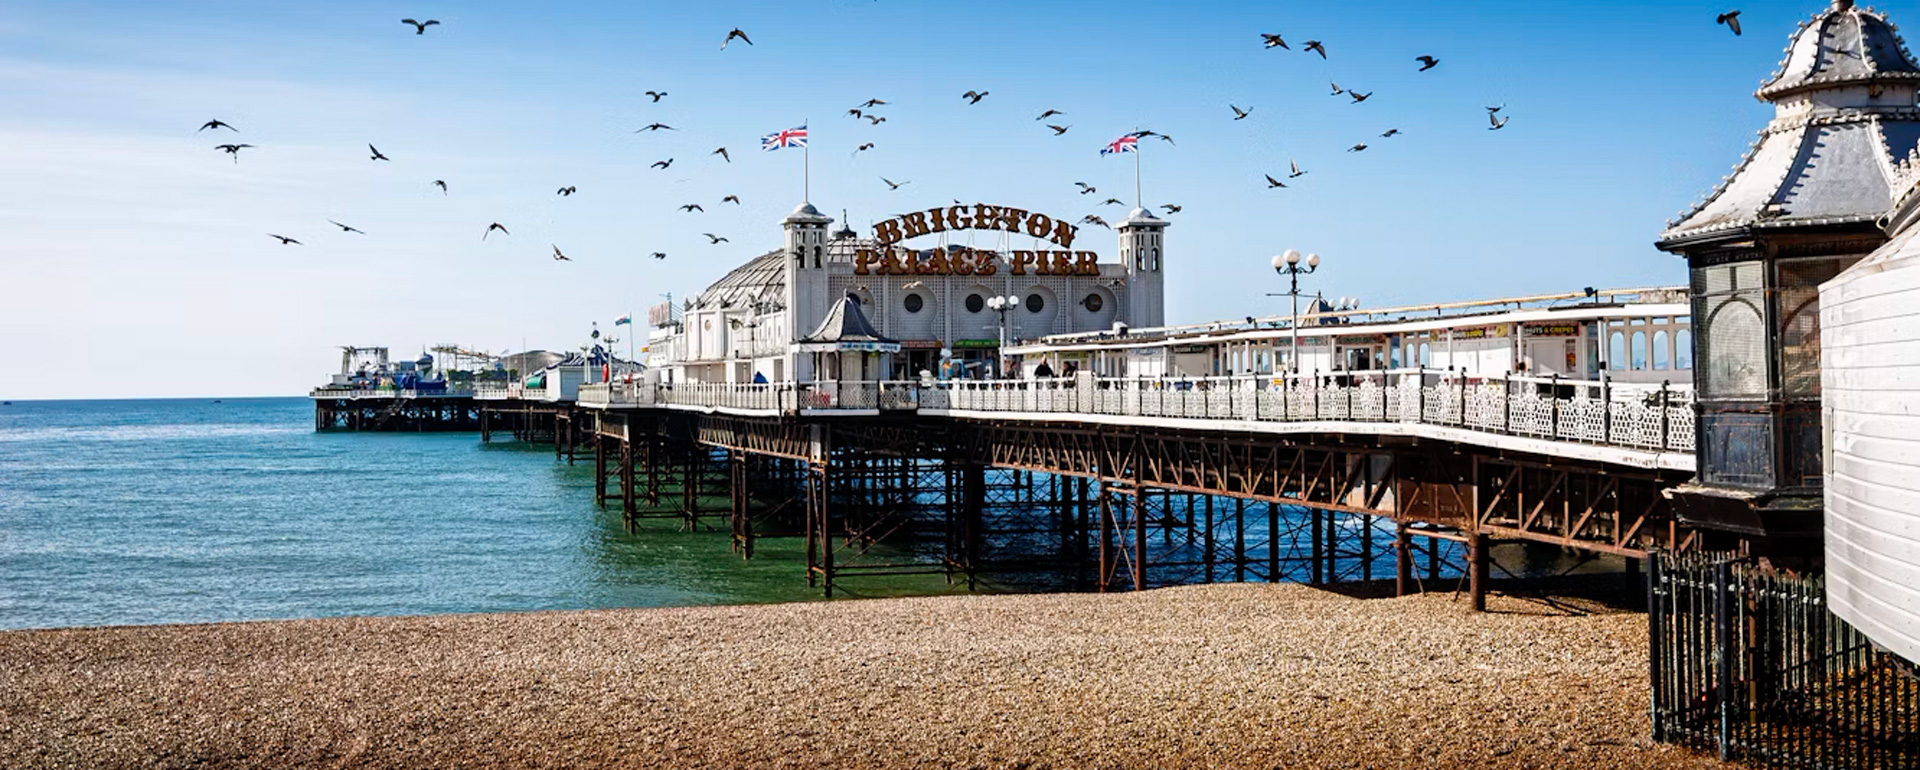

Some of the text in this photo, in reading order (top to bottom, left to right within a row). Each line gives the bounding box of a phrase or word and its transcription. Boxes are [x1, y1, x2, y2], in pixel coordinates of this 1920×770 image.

[873, 203, 1079, 248] BRIGHTON
[854, 248, 1101, 276] PALACE PIER
